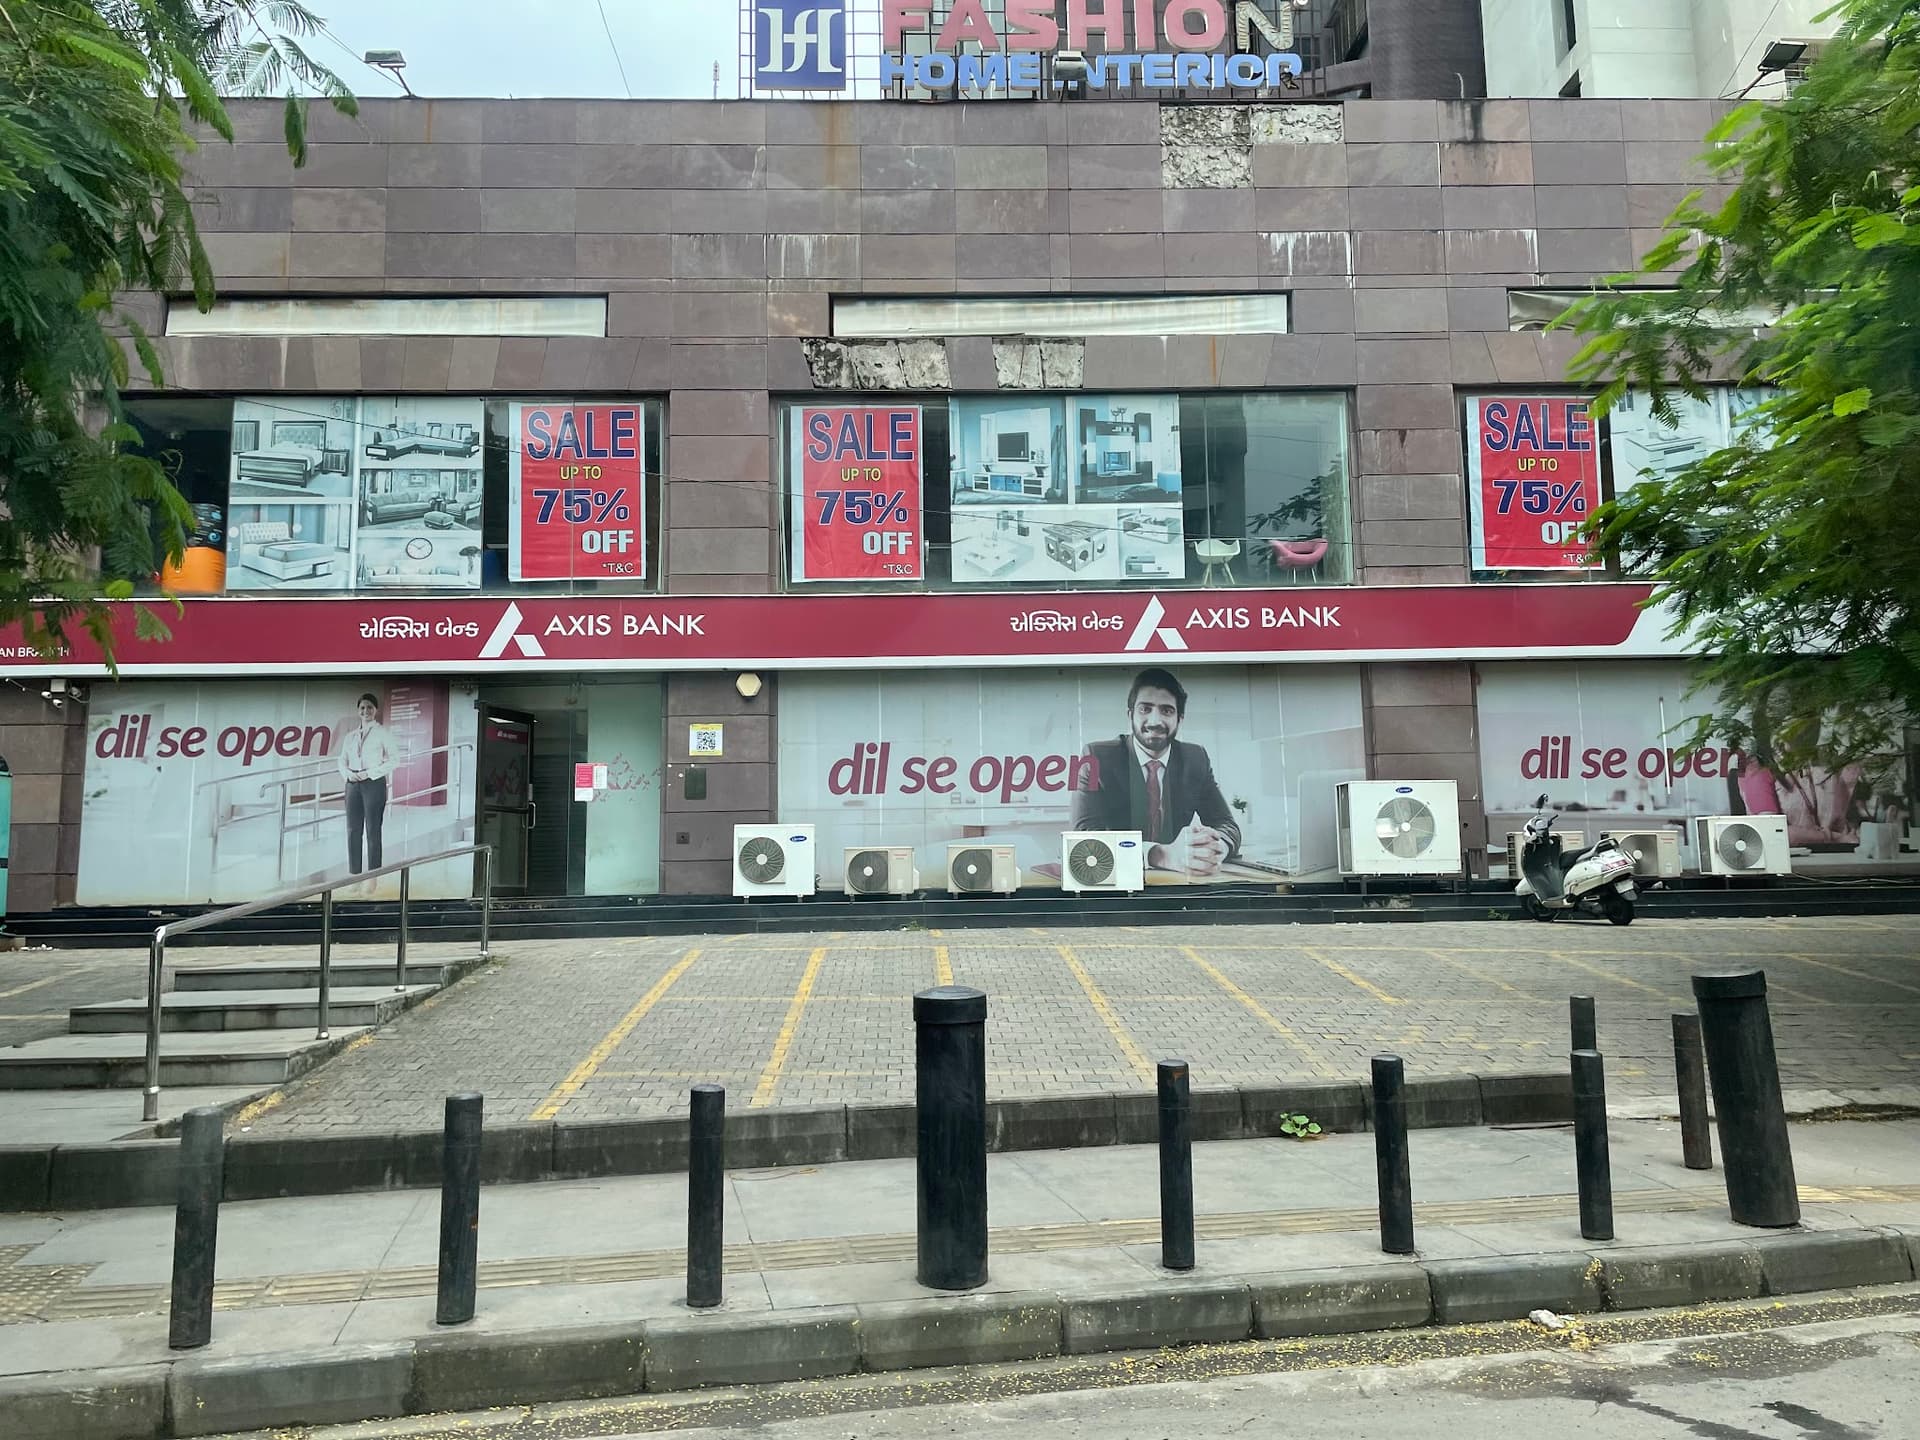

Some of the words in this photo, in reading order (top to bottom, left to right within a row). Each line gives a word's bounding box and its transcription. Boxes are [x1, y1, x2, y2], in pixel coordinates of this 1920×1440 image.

[883, 0, 1295, 51] FASHION
[880, 54, 1041, 91] HOME
[527, 410, 636, 460] SALE
[808, 412, 914, 463] SALE
[1485, 402, 1591, 451] SALE
[560, 466, 579, 480] UP
[583, 466, 602, 480] TO
[841, 468, 859, 482] UP
[863, 468, 882, 482] TO
[1517, 457, 1536, 472] UP
[1540, 457, 1559, 472] TO
[533, 488, 629, 524] 75%
[815, 490, 908, 526] 75%
[1492, 479, 1586, 515] 75%
[582, 530, 634, 553] OFF
[863, 531, 913, 555] OFF
[435, 617, 480, 638] બેન્ક
[544, 614, 612, 637] AXIS
[623, 614, 706, 636] BANK
[1082, 610, 1124, 631] બેન્ક
[1186, 608, 1249, 629] AXIS
[1261, 606, 1341, 628] BANK
[96, 714, 152, 759] dil
[156, 726, 208, 758] se
[216, 725, 331, 766] open
[828, 742, 891, 795] dil
[899, 756, 957, 793] se
[969, 755, 1101, 803] open
[1520, 736, 1571, 779] dil
[1581, 747, 1627, 779] se
[1637, 747, 1746, 787] open
